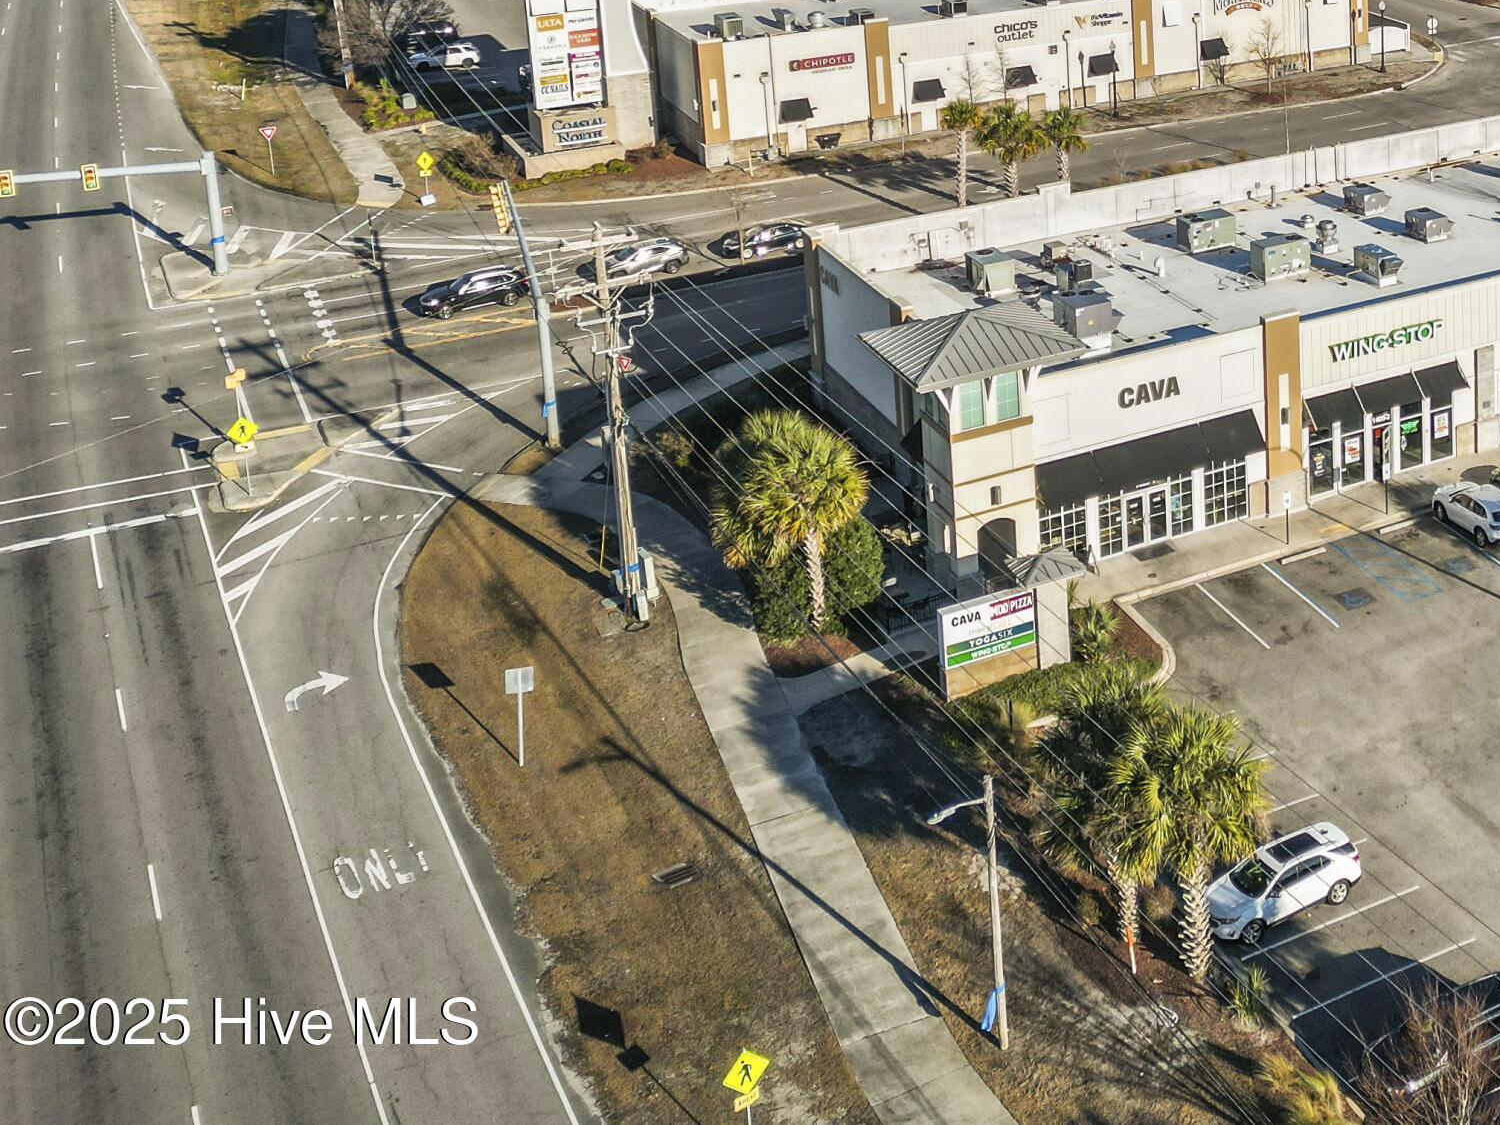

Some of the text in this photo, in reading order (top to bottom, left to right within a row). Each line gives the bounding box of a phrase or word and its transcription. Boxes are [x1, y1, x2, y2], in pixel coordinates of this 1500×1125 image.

[537, 18, 562, 29] ULTA
[994, 20, 1038, 34] chico's
[997, 30, 1035, 43] outlet
[804, 55, 853, 68] CHIPOTLE
[551, 116, 607, 131] COASTAL
[557, 130, 603, 143] NORTH
[1117, 376, 1181, 409] CAVA
[1010, 595, 1033, 612] PIZZA
[951, 611, 982, 627] CAVA
[969, 628, 1014, 648] YOGASIX
